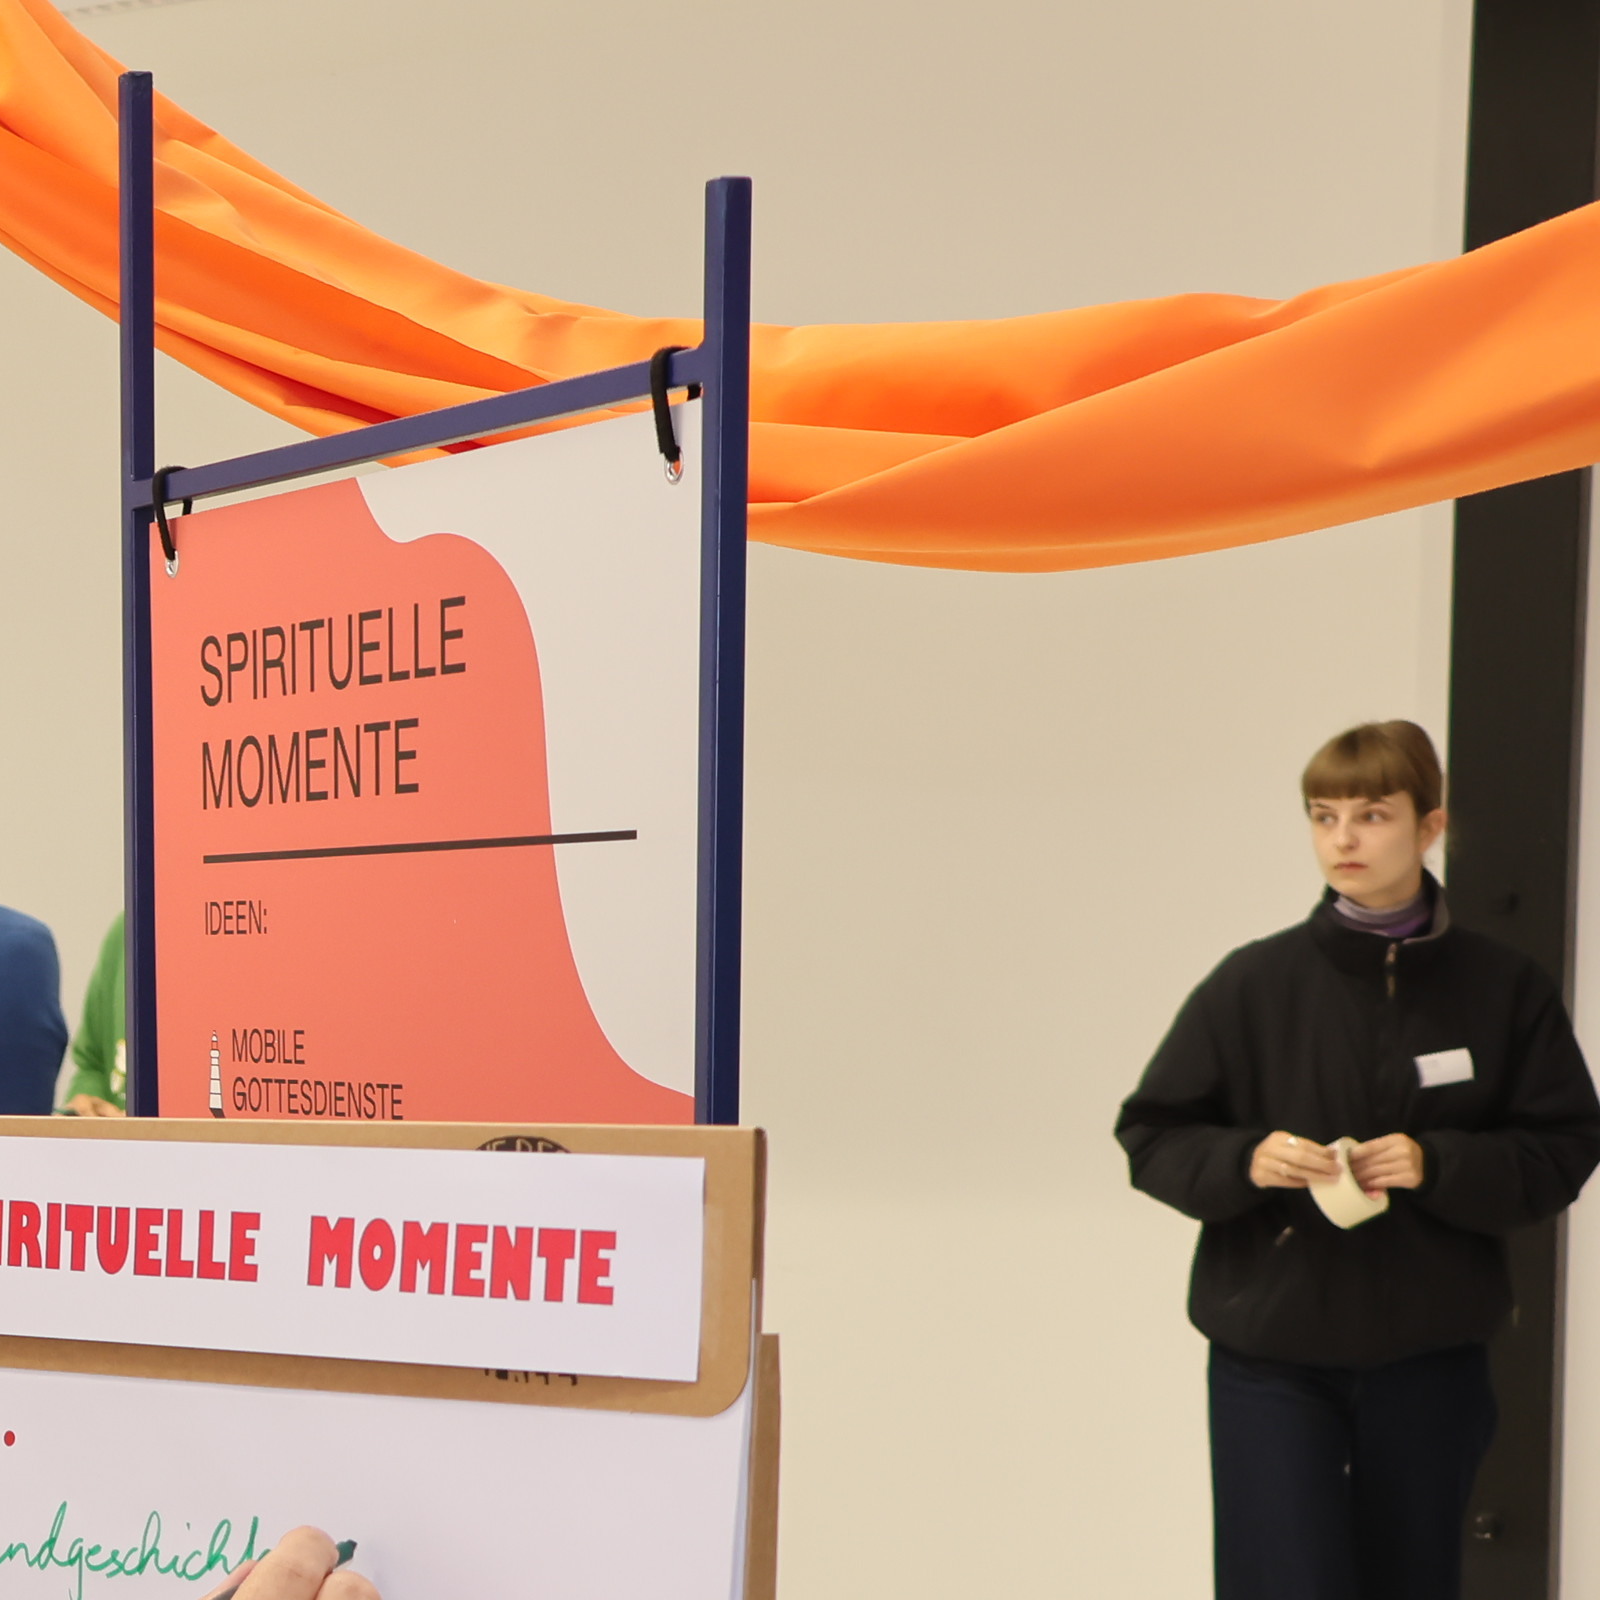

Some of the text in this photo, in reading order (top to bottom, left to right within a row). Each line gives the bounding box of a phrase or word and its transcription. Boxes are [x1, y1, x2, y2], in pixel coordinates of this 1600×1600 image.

[200, 595, 466, 706] SPIRITUELLE
[202, 718, 420, 810] MOMENTE
[204, 901, 268, 936] IDEEN:
[231, 1029, 306, 1066] MOBILE
[231, 1076, 404, 1121] GOTTESDIENSTE
[306, 1214, 617, 1306] MOMENTE
